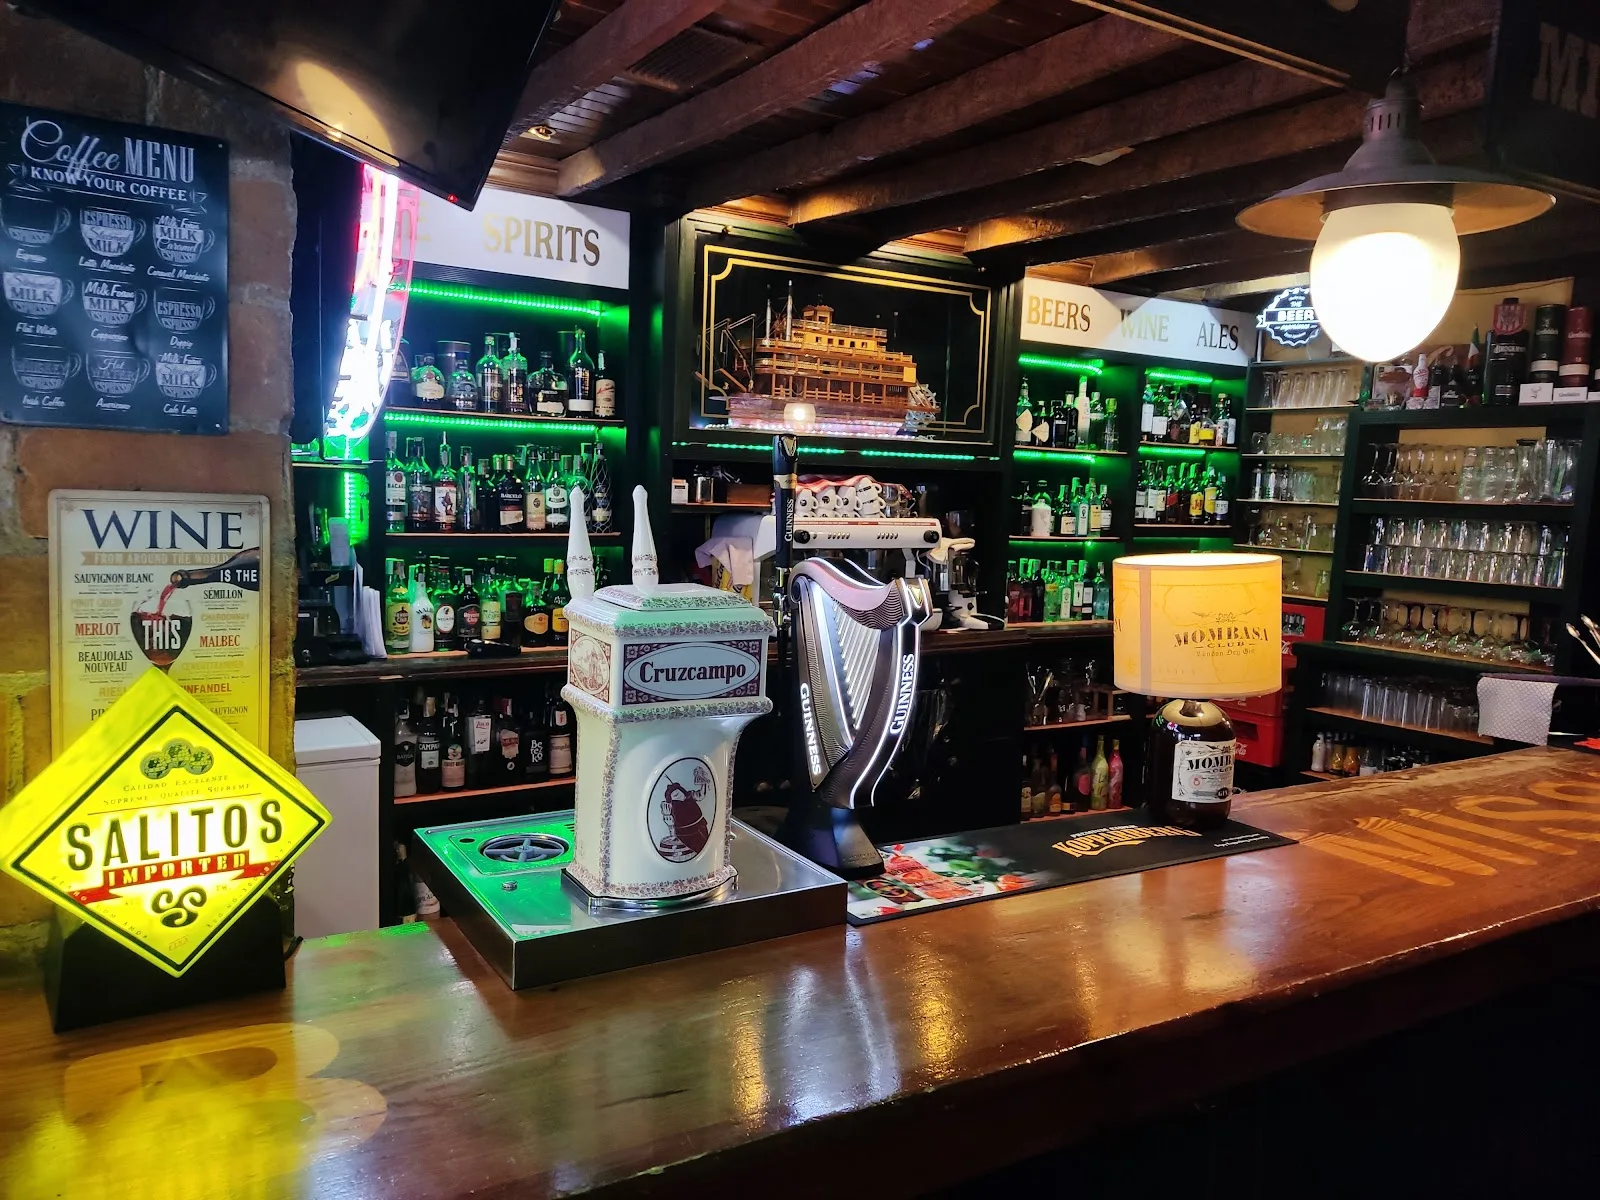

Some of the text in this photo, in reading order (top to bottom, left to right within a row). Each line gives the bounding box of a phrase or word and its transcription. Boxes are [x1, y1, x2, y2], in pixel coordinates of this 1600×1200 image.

[21, 116, 194, 183] Coffee MENU
[31, 166, 187, 201] KNOW YOUR COFFEE
[84, 210, 131, 231] ESPRESSO
[159, 229, 198, 241] MILK
[482, 213, 600, 267] SPIRITS
[88, 237, 127, 252] MILK
[158, 237, 199, 252] Caramel
[11, 286, 54, 302] MILK
[85, 282, 109, 296] Milk
[89, 299, 129, 312] MILK
[158, 302, 201, 317] ESPRESSO
[1277, 308, 1315, 321] BEER
[1027, 295, 1239, 350] BEERS WINE ALES
[98, 358, 125, 370] Hot
[162, 374, 198, 386] MILK
[784, 498, 794, 542] GUINNESS
[80, 509, 244, 549] WINE
[94, 553, 230, 566] FROM AROUND THE WORLD
[74, 573, 154, 583] SAUVIGNON BLANC
[220, 570, 257, 582] IS THE
[75, 623, 120, 636] MERLOT
[142, 620, 181, 650] THIS
[1174, 626, 1269, 647] MOMBASA
[200, 635, 240, 647] MALBEC
[78, 651, 133, 662] BEAUJOLAIS
[84, 662, 127, 673] NOUVEAU
[639, 661, 746, 684] Cruzcampo
[889, 653, 914, 734] GUINNESS
[800, 683, 821, 775] GUINNESS
[123, 782, 167, 792] CALIDAD
[67, 800, 282, 871] SALITOS
[108, 852, 246, 887] IMPORTED
